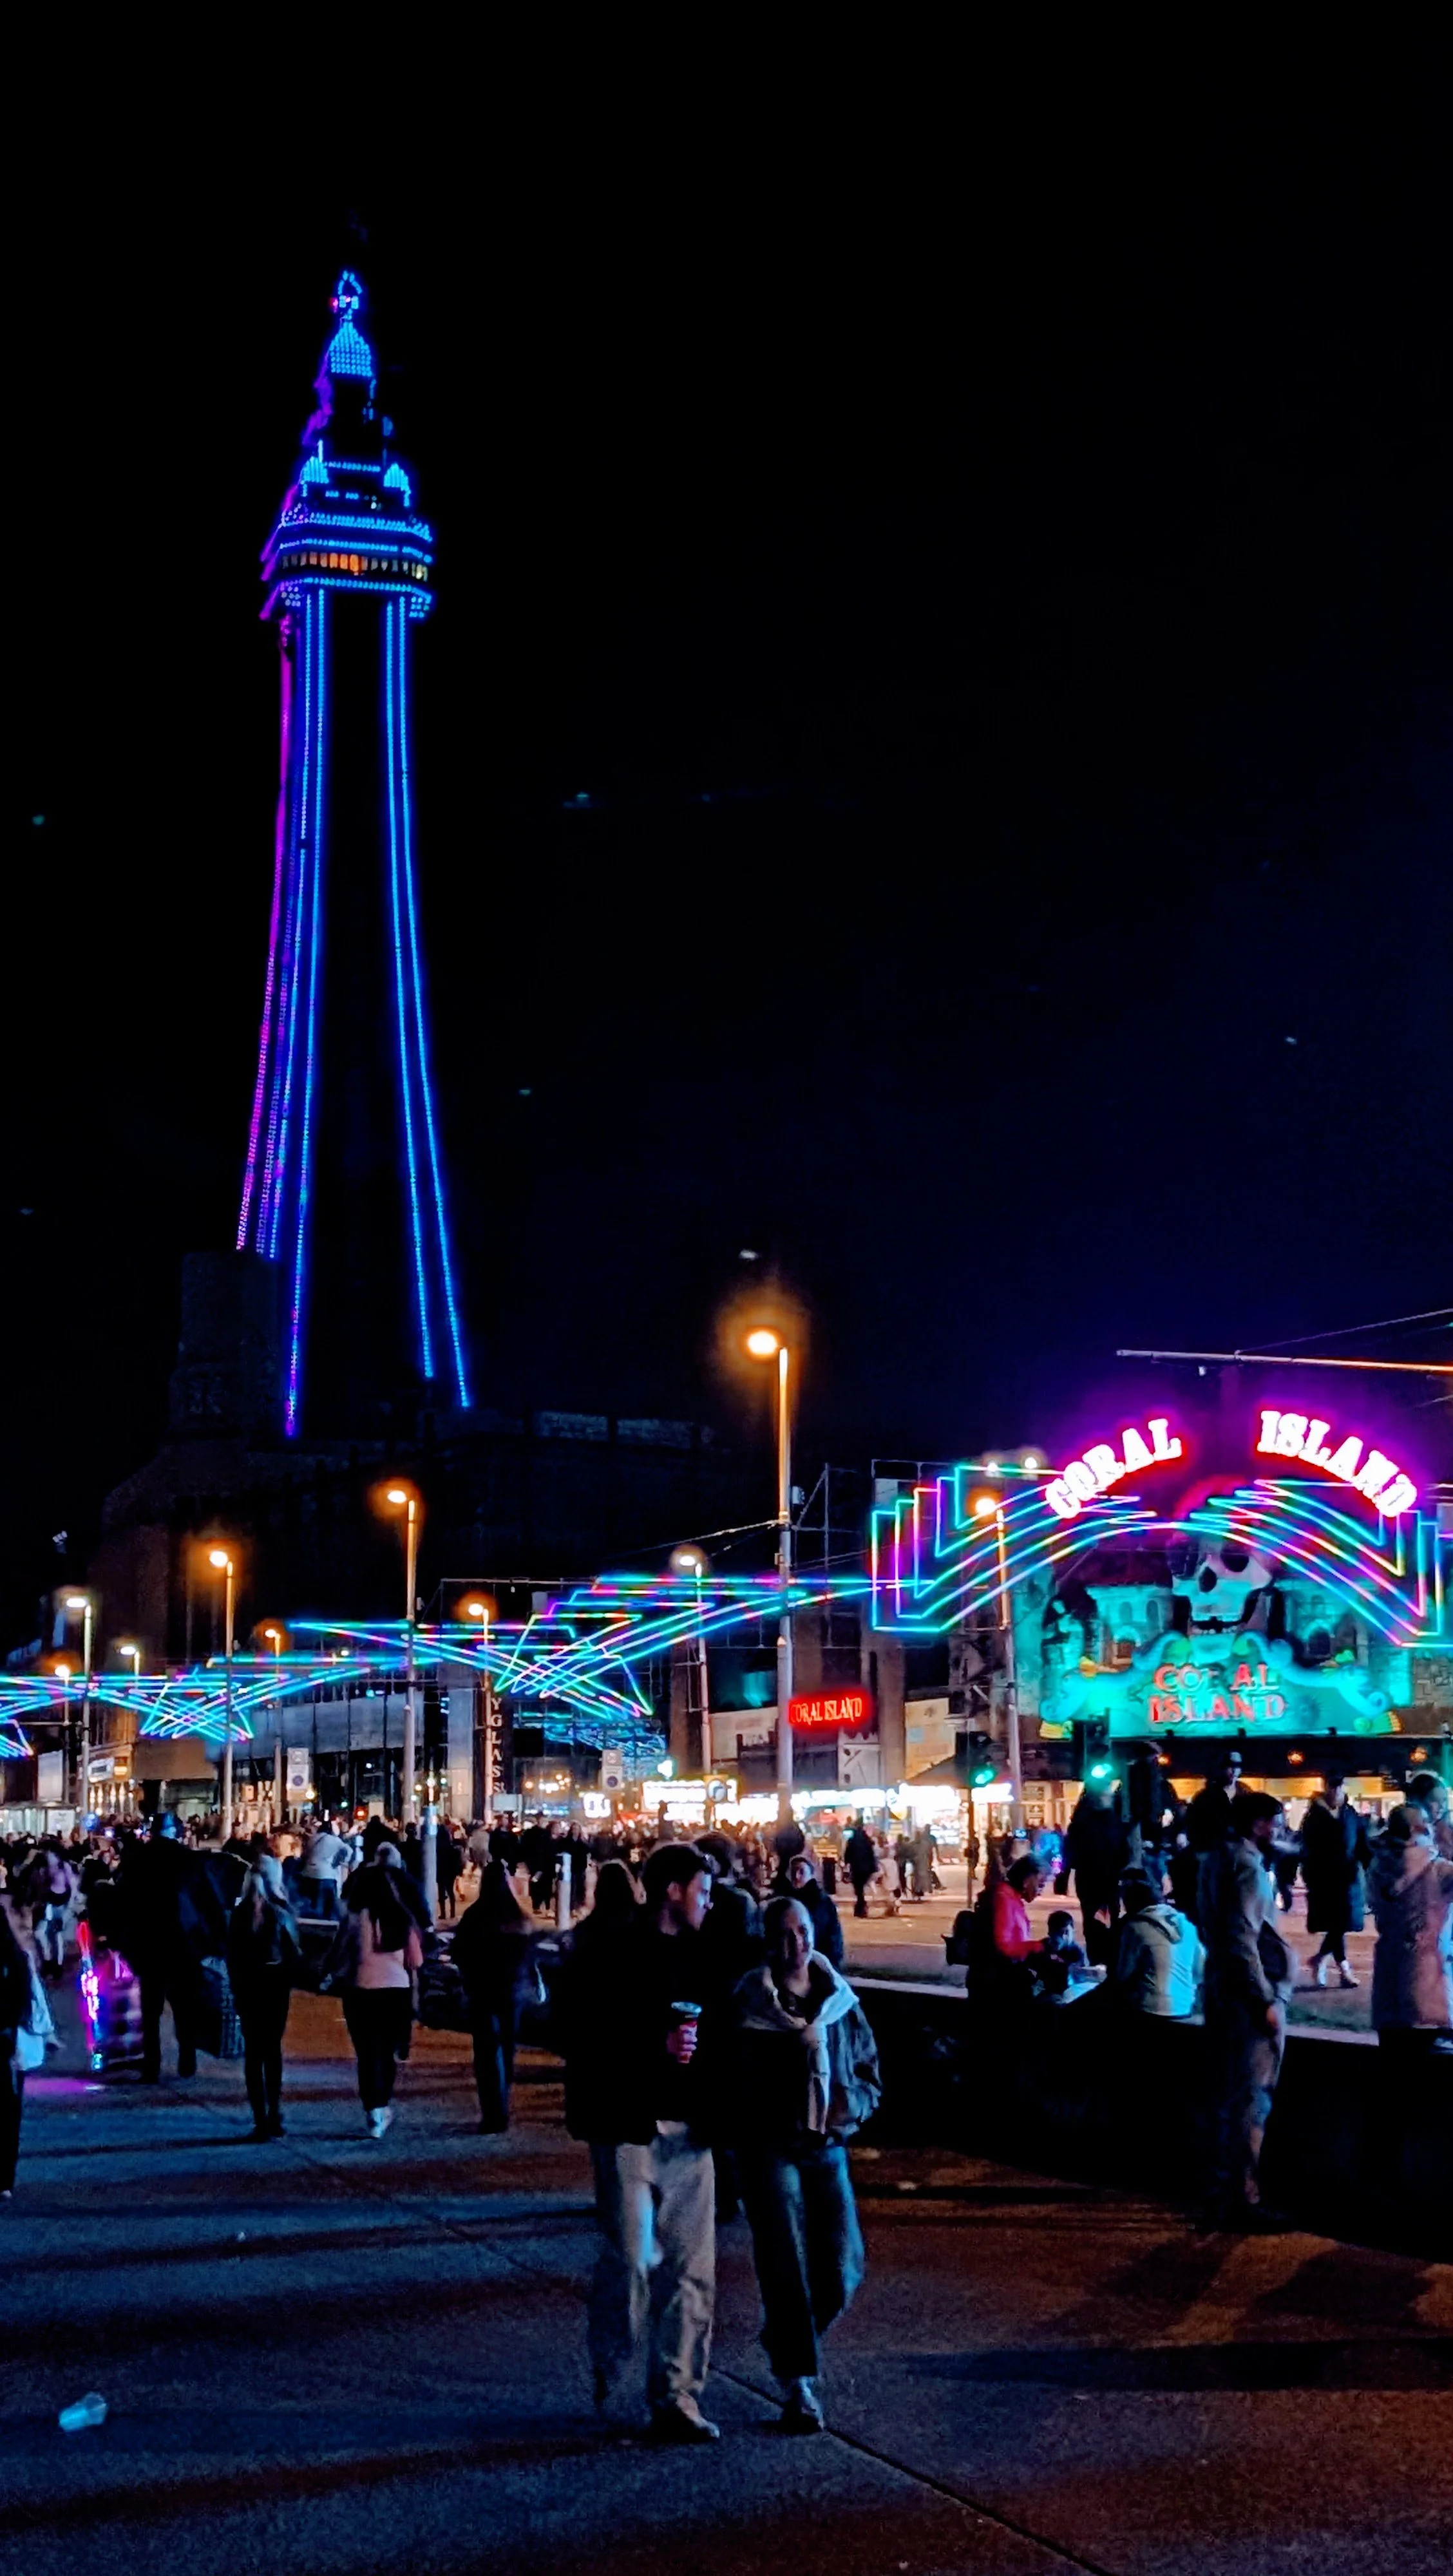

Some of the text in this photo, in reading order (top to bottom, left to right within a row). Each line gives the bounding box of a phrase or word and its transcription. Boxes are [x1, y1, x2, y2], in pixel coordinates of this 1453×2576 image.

[1045, 1410, 1418, 1519] CORAL ISLAND
[824, 1697, 862, 1722] ISLAND
[1148, 1694, 1289, 1723] ISLAND
